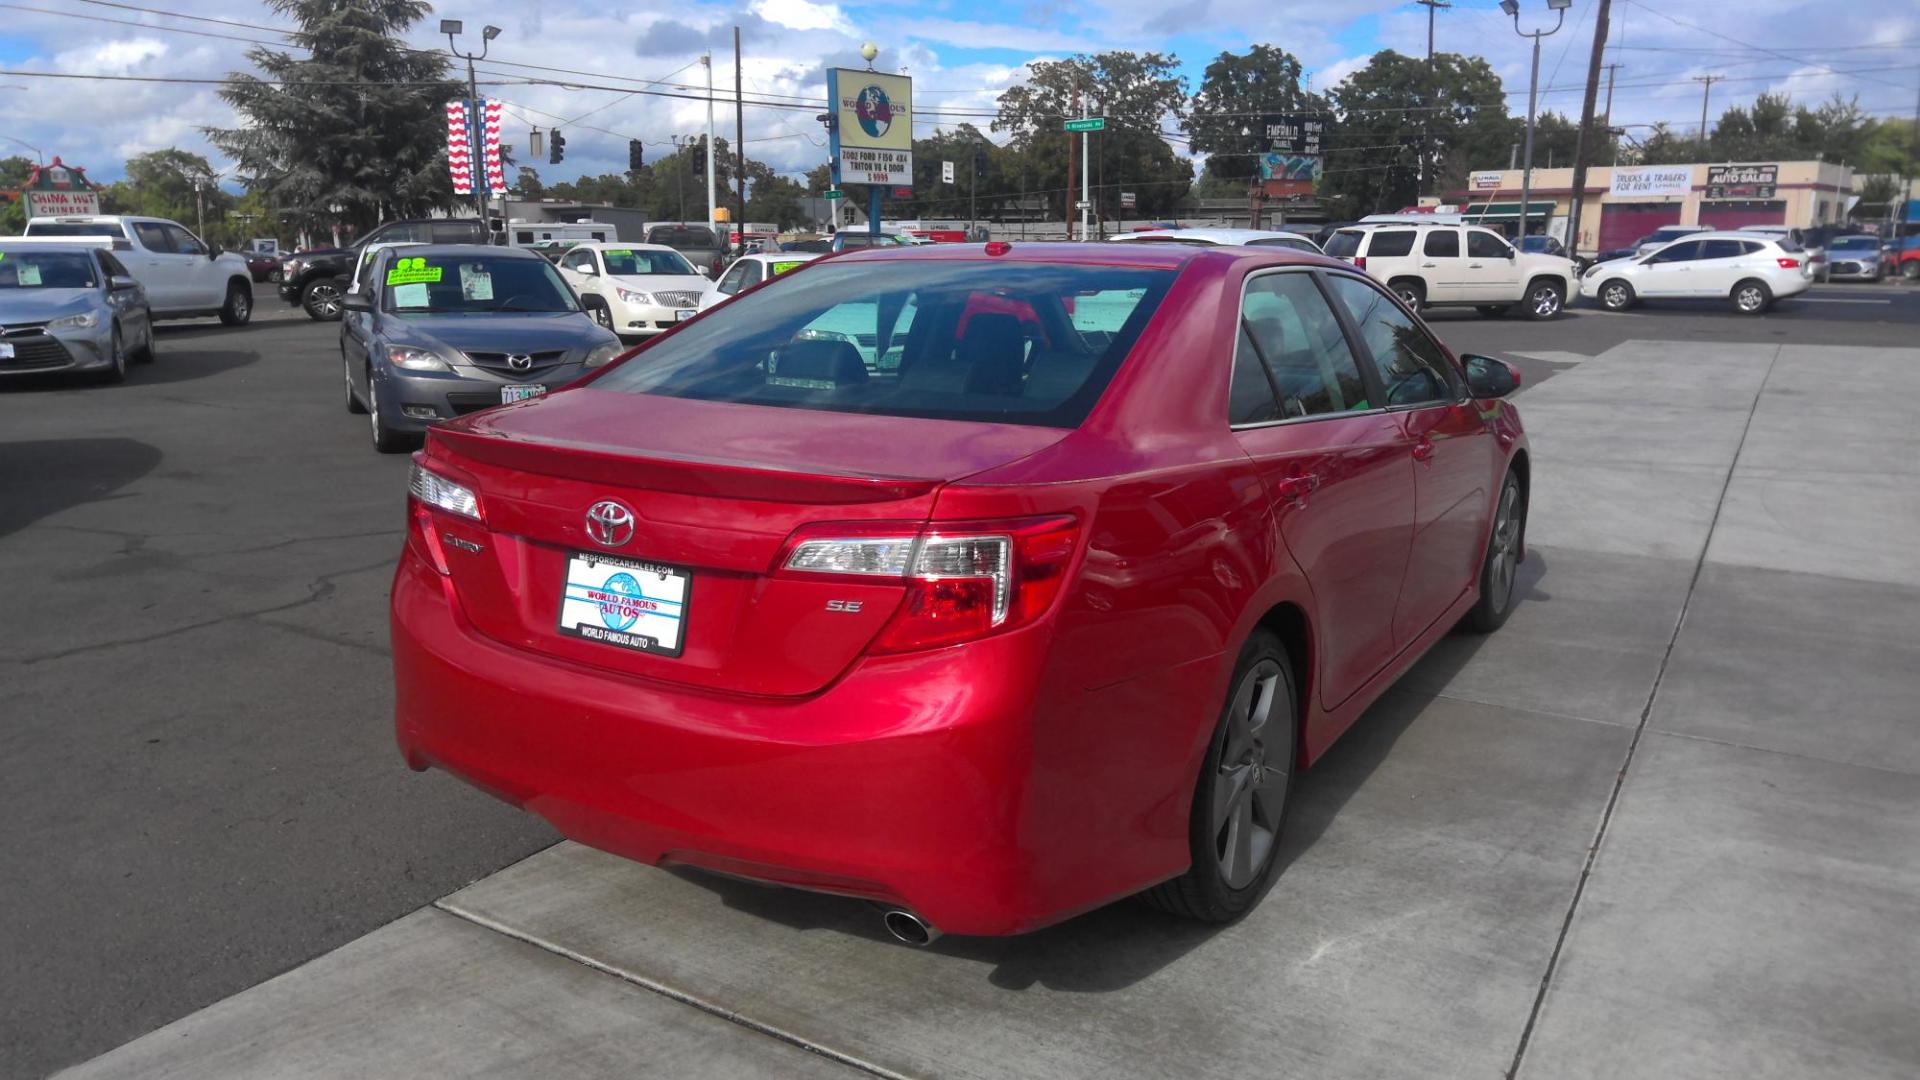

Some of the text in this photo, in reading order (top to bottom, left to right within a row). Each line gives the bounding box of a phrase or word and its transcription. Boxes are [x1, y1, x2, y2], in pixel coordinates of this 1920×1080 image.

[842, 150, 858, 160] 2002
[859, 151, 876, 161] FORD
[850, 161, 873, 171] TRITON
[888, 163, 905, 173] DOOR
[872, 173, 889, 182] 9999
[1616, 173, 1643, 183] TRUCKS
[1711, 173, 1773, 184] AUTO SALES
[1616, 182, 1631, 191] FOR
[1633, 181, 1652, 191] RENT
[30, 192, 95, 205] CHINA HUT
[40, 205, 89, 214] CHINESE
[444, 533, 484, 552] CAMRY
[578, 553, 674, 576] MEDFORDCARSALES.COM
[587, 590, 657, 611] WORLD FAMOUS
[825, 600, 864, 612] SE
[601, 604, 640, 619] AUTOS
[581, 625, 648, 649] WORLD FAMOUS AUTO
